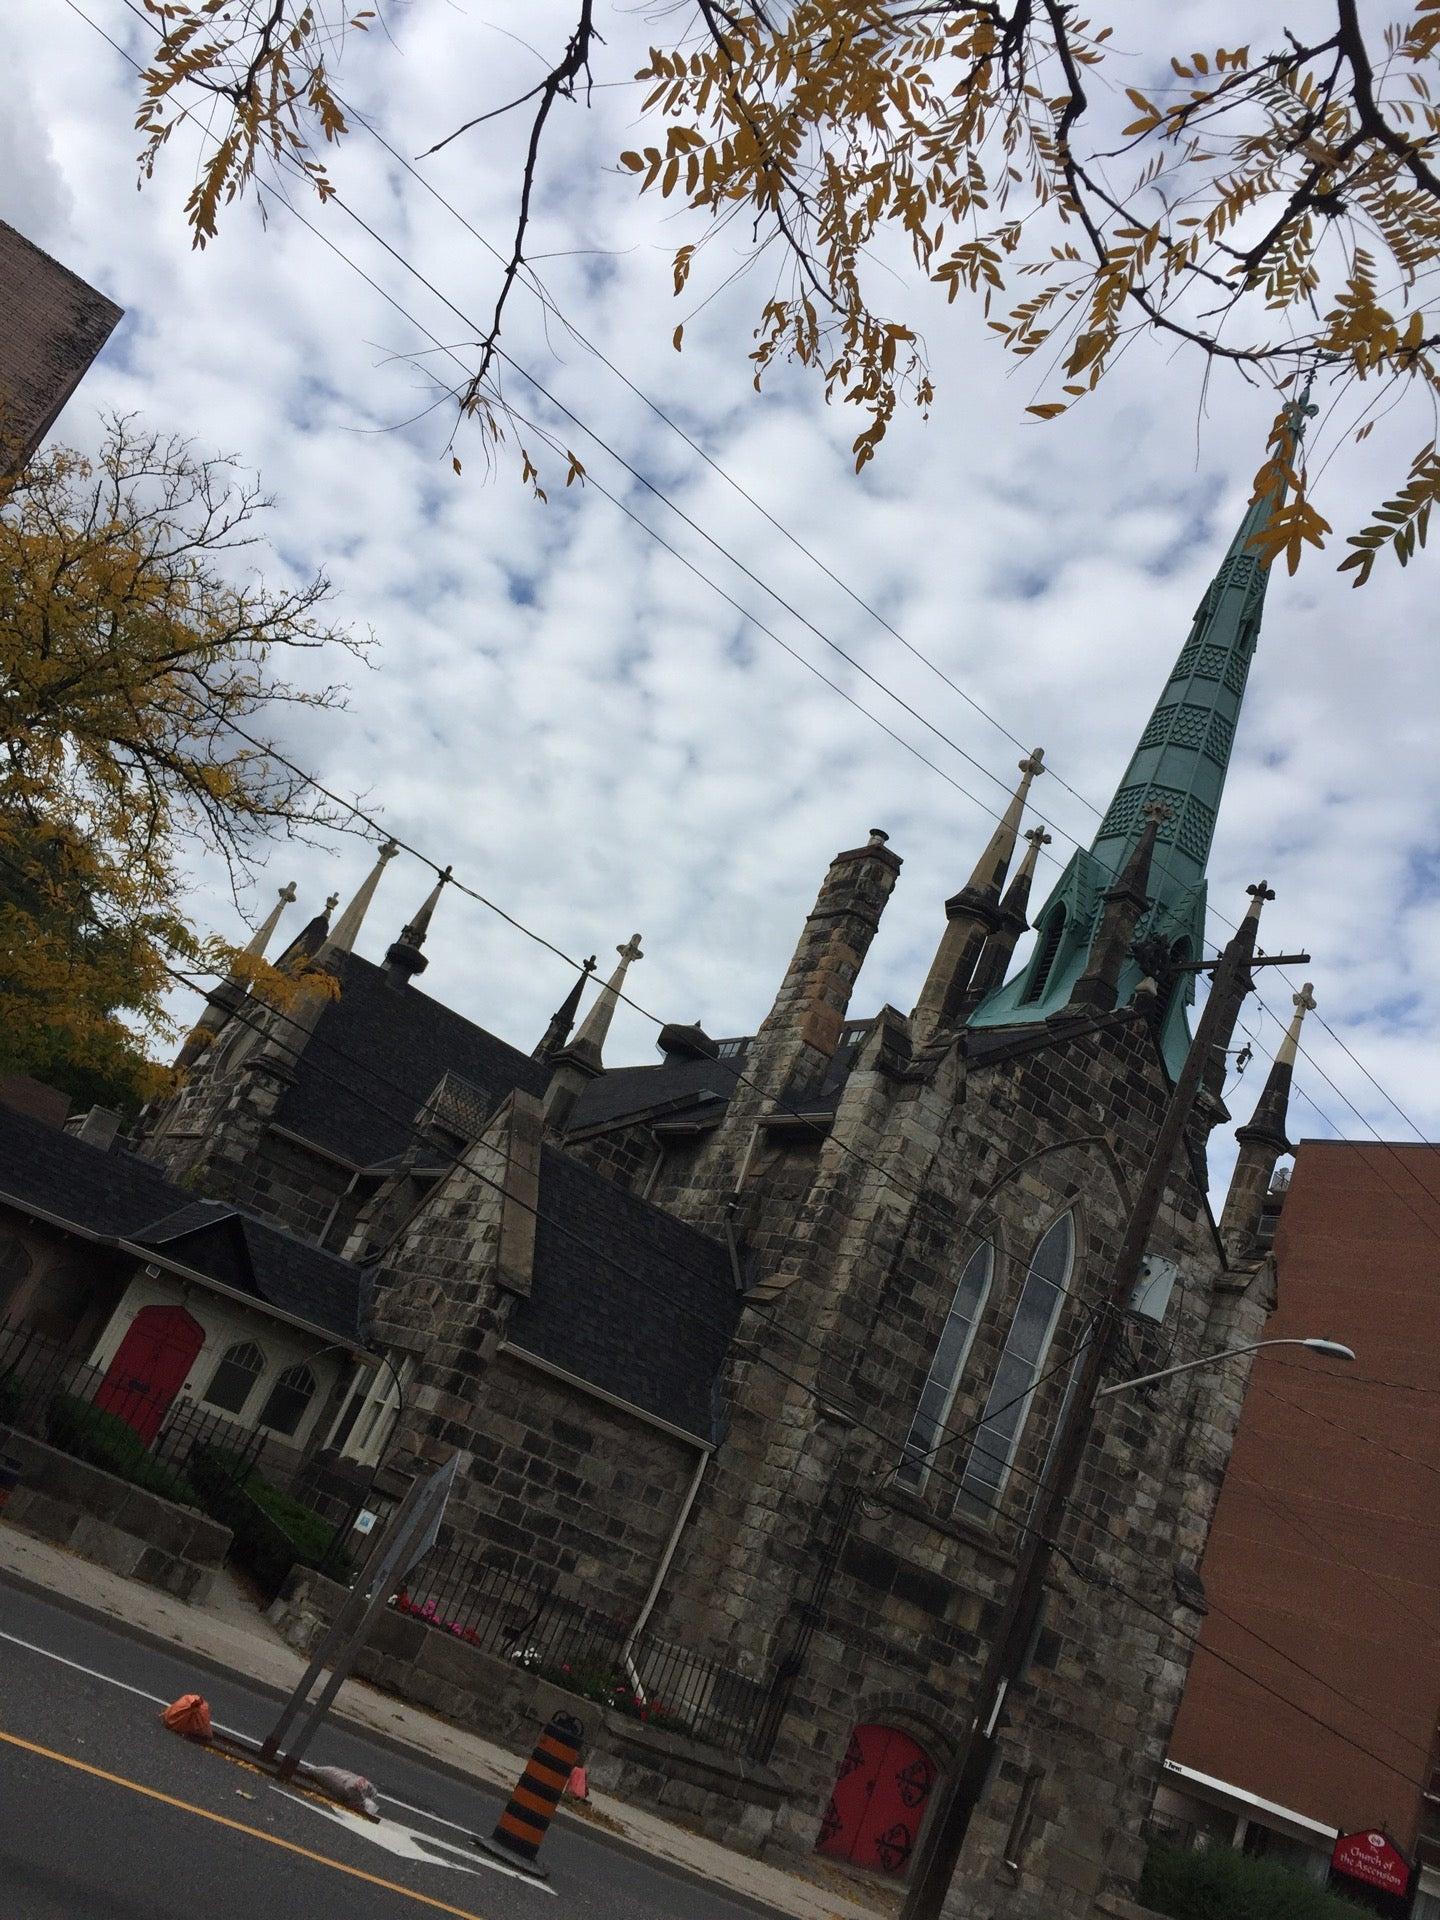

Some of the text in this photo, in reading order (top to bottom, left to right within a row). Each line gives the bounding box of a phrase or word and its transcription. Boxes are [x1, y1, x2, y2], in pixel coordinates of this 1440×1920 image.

[1340, 1852, 1355, 1866] the
[1356, 1860, 1401, 1886] Ascension
[1350, 1847, 1396, 1871] Church of
